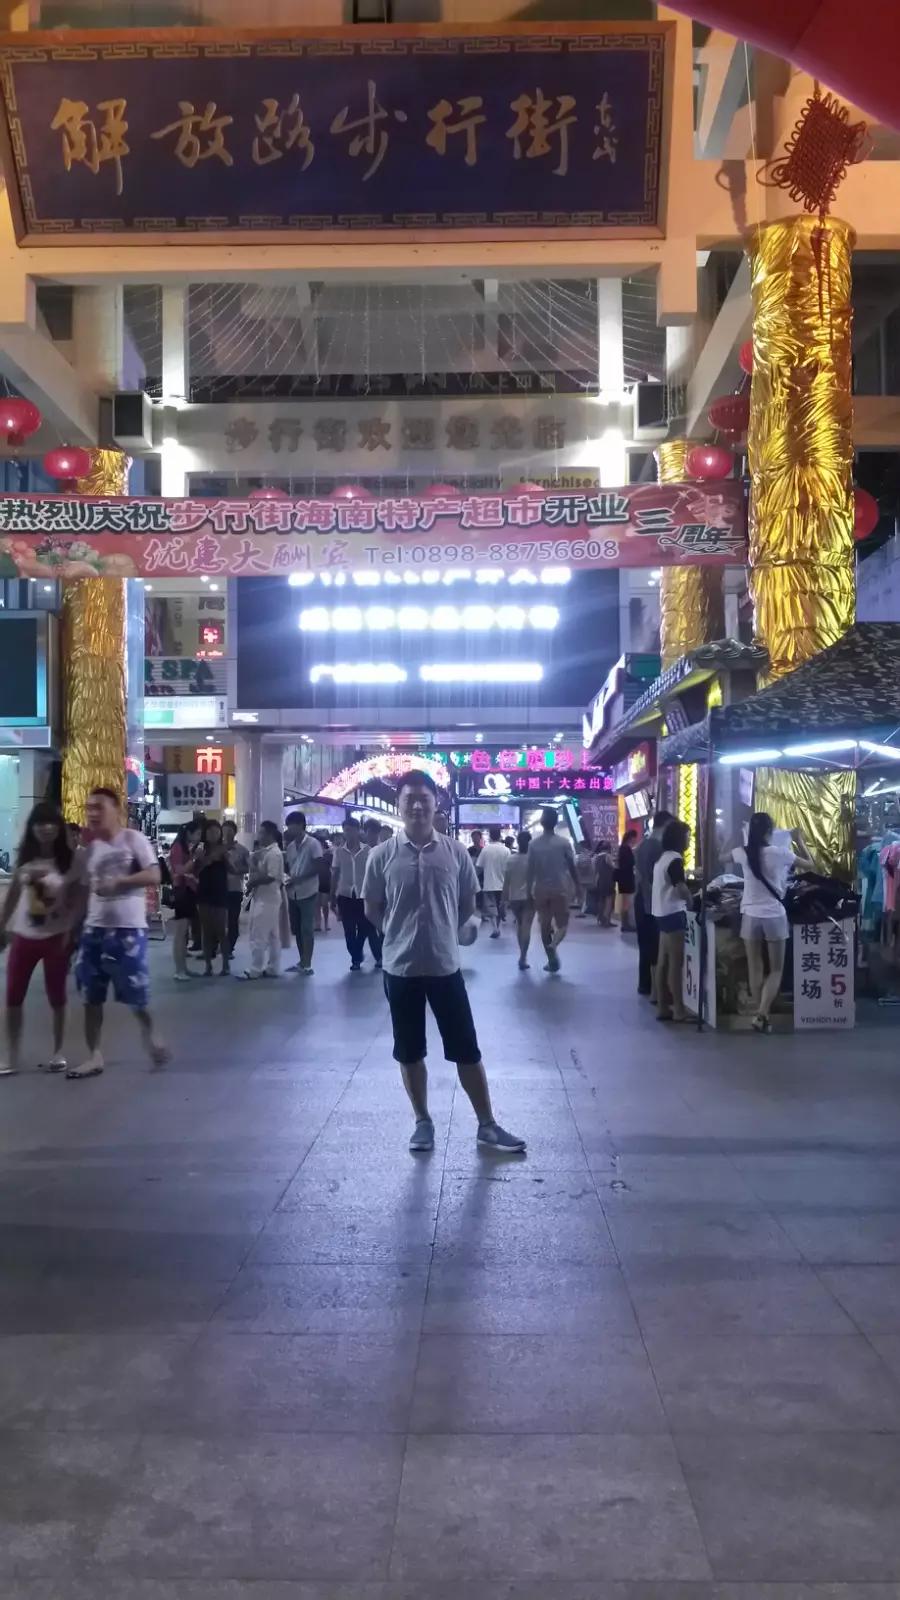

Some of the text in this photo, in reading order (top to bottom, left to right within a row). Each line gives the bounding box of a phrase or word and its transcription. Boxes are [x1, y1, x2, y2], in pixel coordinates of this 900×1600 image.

[50, 80, 579, 196] 解放路步行街
[1, 494, 630, 534] 热烈庆祝步行街海南特产超市开业
[144, 538, 351, 573] 优惠大酬宾
[364, 540, 621, 567] Tel:0898-88756608
[196, 747, 223, 773] 市
[801, 924, 821, 1000] 特卖场
